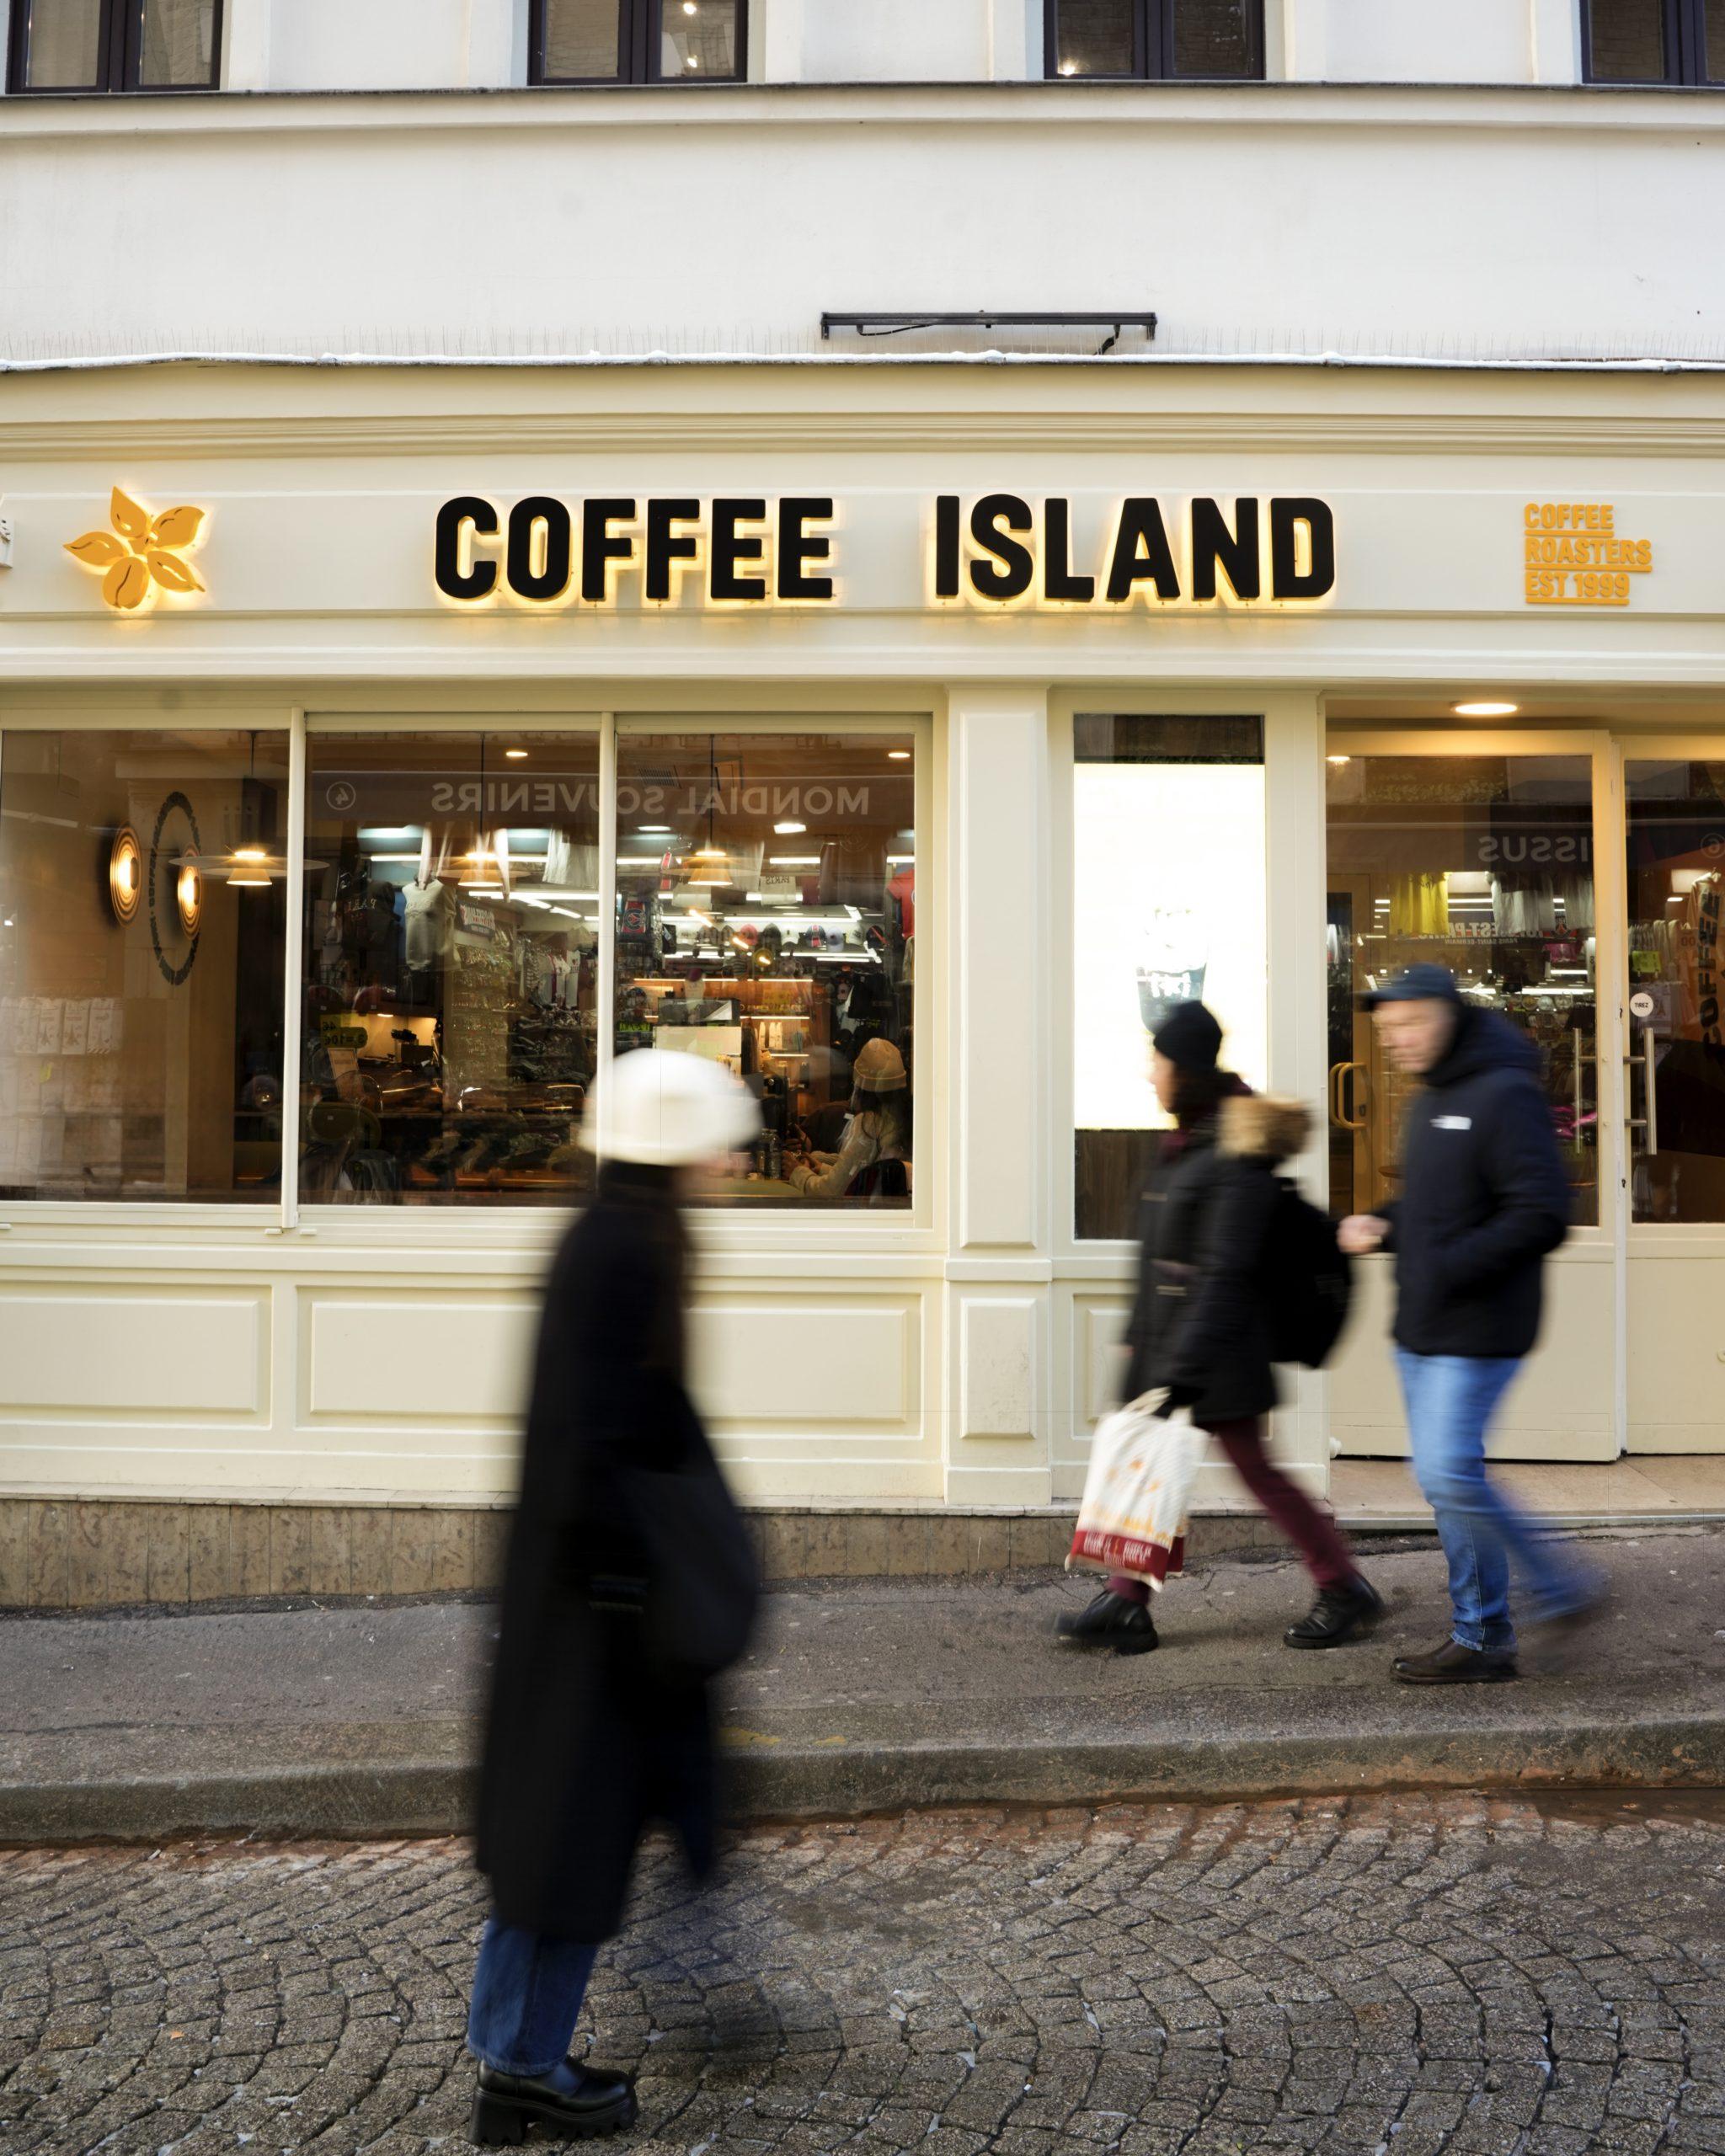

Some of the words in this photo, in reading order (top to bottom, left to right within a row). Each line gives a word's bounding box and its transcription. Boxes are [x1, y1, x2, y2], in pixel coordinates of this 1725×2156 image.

[1524, 503, 1614, 529] COFFEE
[434, 495, 834, 600] COFFEE
[937, 494, 1336, 600] ISLAND
[1525, 537, 1653, 565] ROASTERS
[1525, 571, 1568, 597] EST
[1573, 572, 1630, 598] 1999
